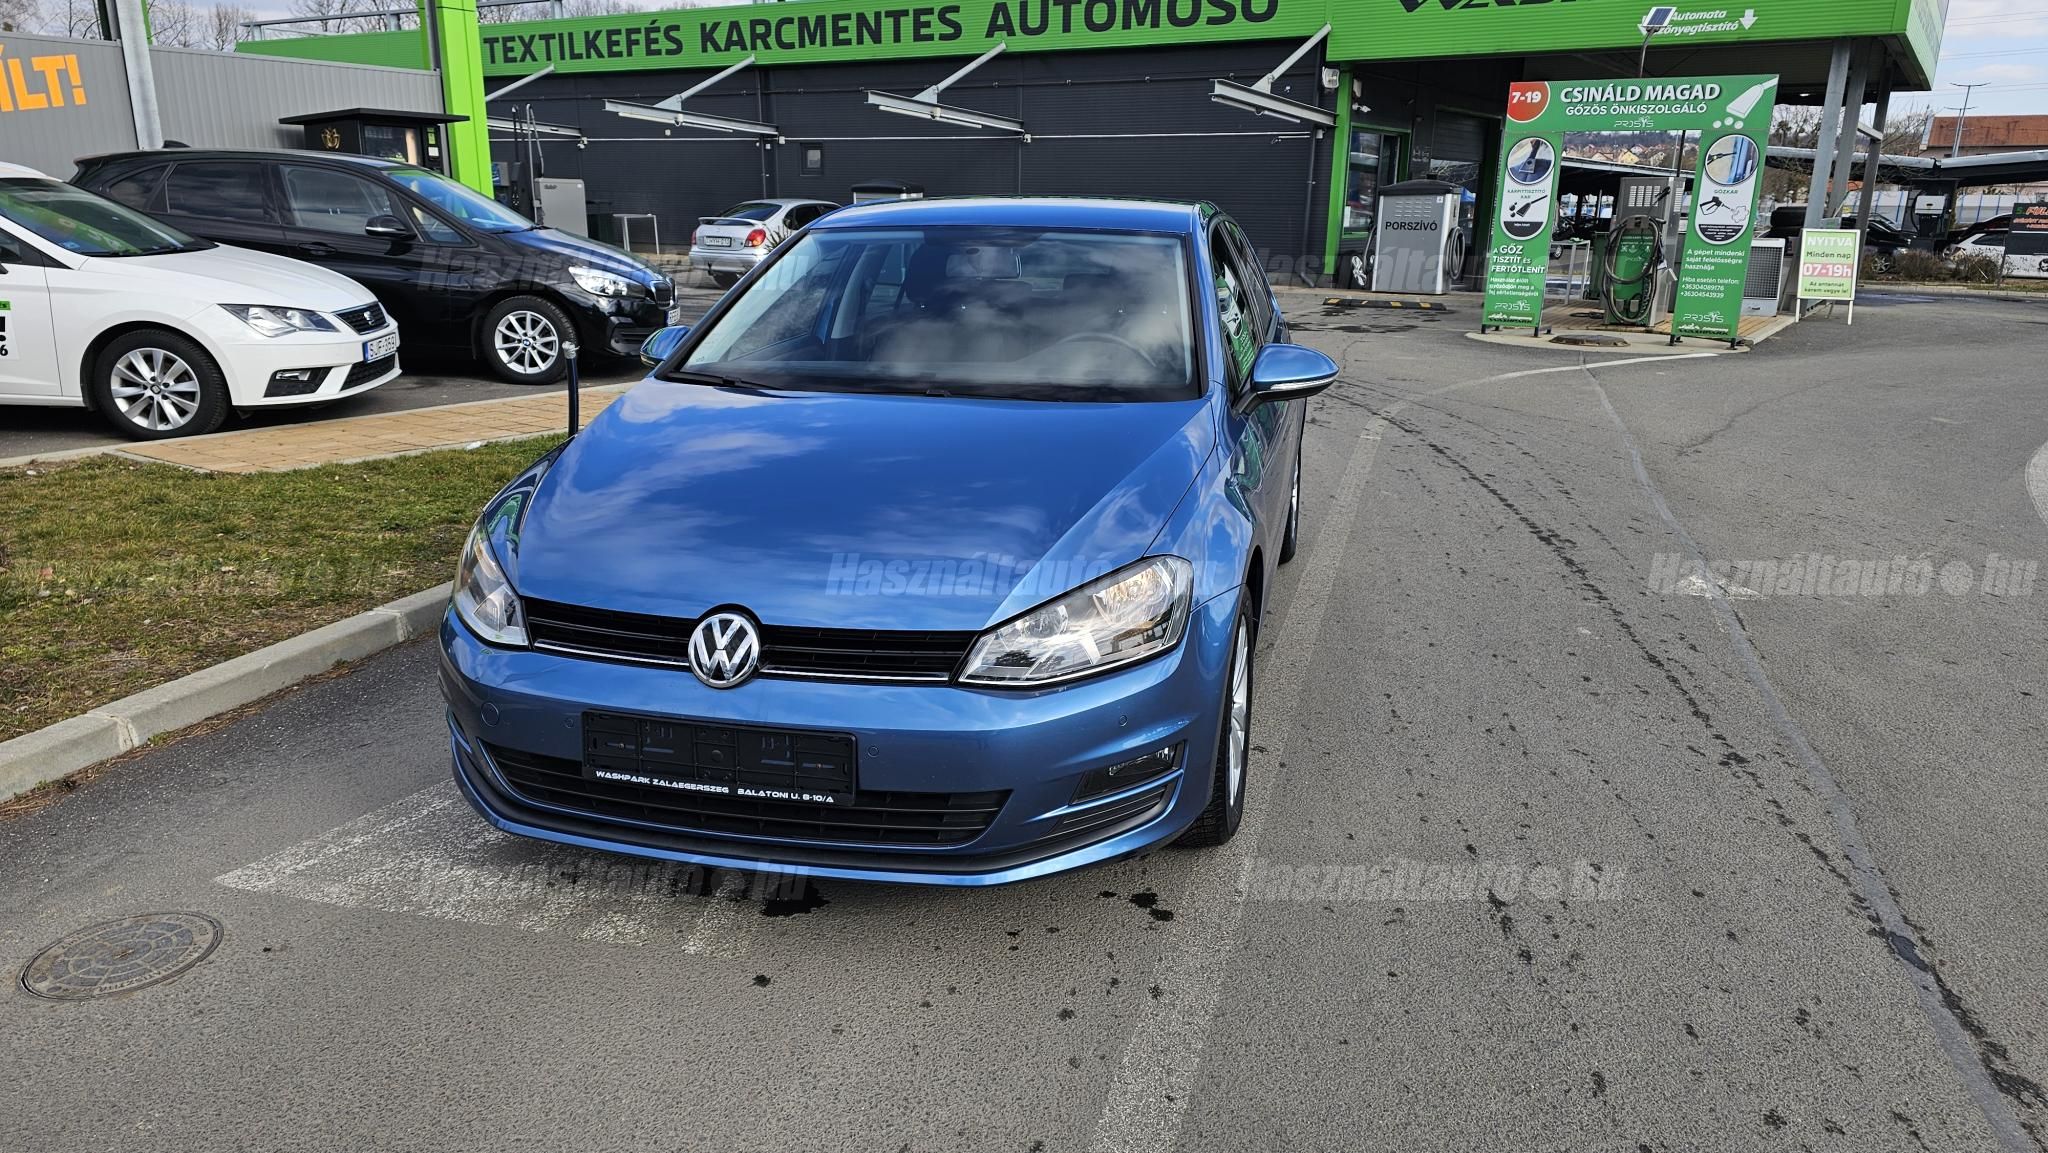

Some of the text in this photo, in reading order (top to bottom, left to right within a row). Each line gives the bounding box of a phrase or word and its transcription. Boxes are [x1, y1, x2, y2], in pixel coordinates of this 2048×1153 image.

[1672, 10, 1727, 21] Automata
[1656, 20, 1739, 36] zőnyegtisztító
[484, 19, 683, 64] TEXTILKEFÉS
[700, 6, 963, 53] KARCMENTES
[1512, 92, 1542, 104] 7-19
[1560, 83, 1721, 103] CSINÁLD MAGAD
[1566, 102, 1707, 116] GŐZÖS ÖNKISZOLGÁLÓ
[1385, 219, 1438, 231] PORSZÍVÓ
[1807, 236, 1853, 246] NYITVA
[1500, 243, 1523, 254] GŐZ
[1492, 255, 1521, 264] TISZTÍT
[1491, 264, 1545, 274] FERTŐTLENÍT
[1803, 263, 1851, 277] 07-19h
[596, 770, 651, 784] WASHPARK
[652, 778, 729, 794] ZALAEGERSZEG
[737, 788, 789, 799] BALATONI
